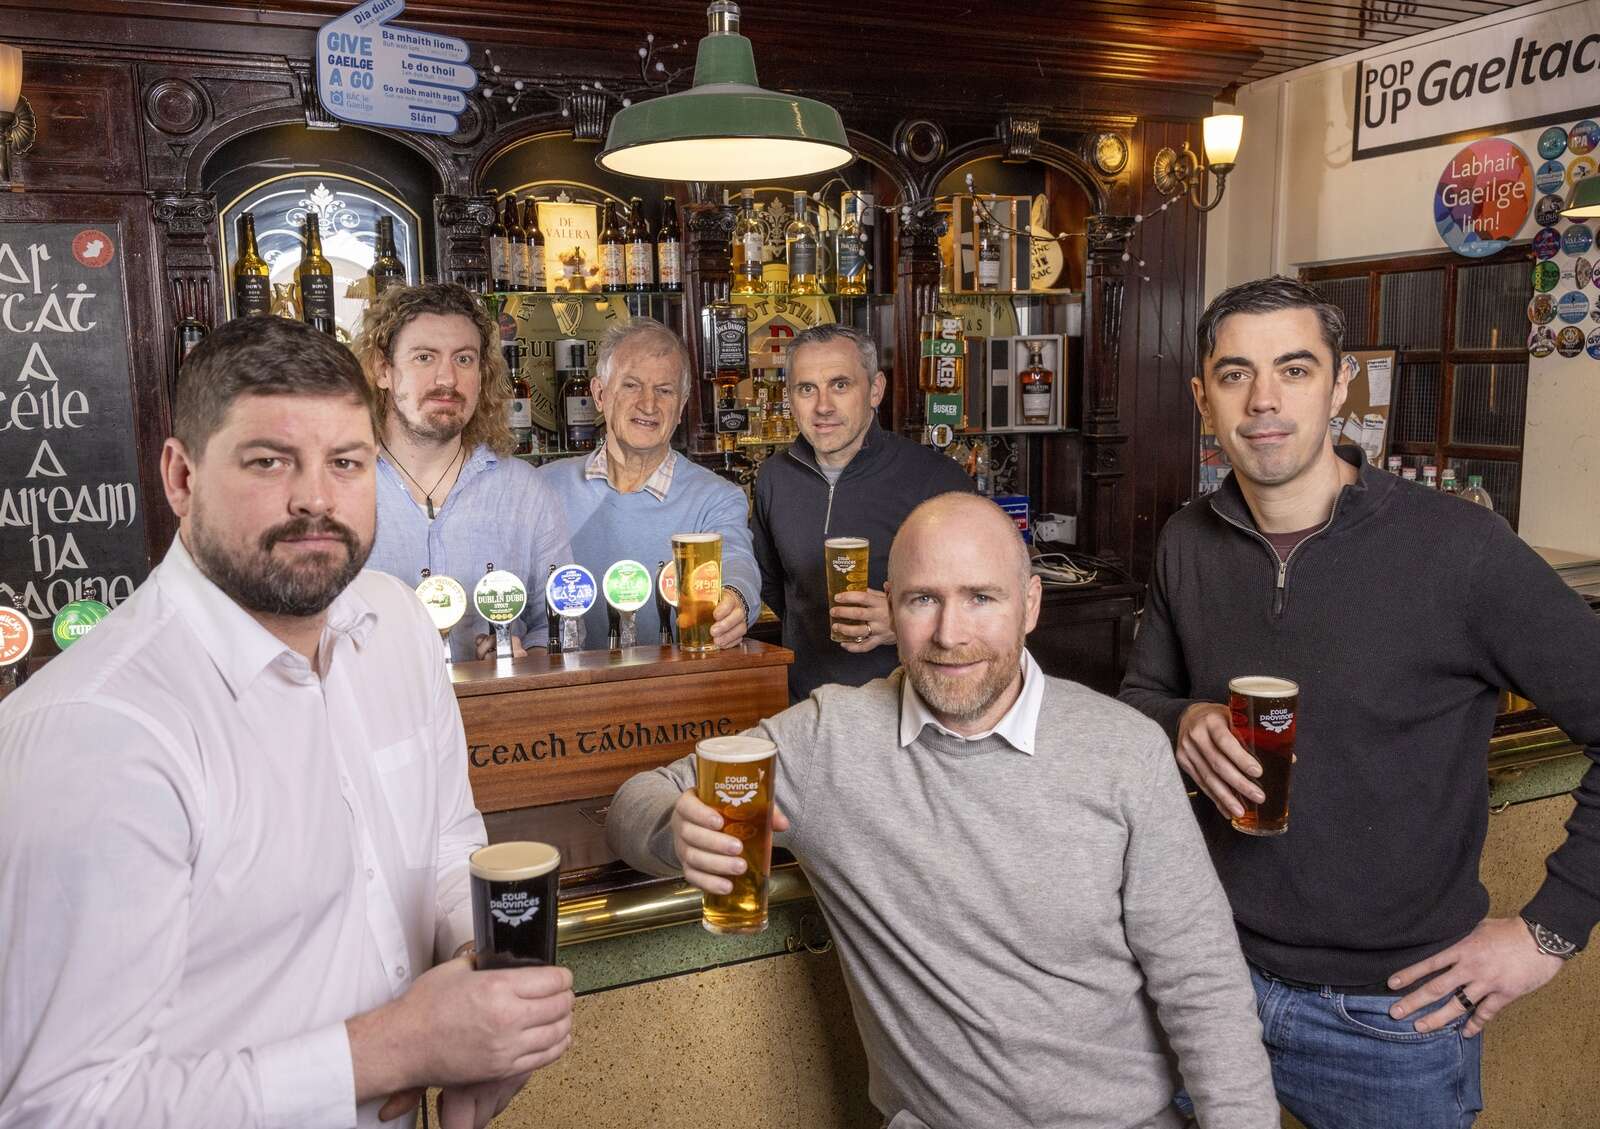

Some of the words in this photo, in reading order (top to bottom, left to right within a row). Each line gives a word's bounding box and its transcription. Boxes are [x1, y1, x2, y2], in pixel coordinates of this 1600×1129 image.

[353, 9, 374, 25] Dia
[327, 32, 373, 57] GIVE
[382, 31, 394, 39] Ba
[397, 34, 431, 47] mhaith
[328, 55, 374, 70] GAEILGE
[402, 60, 414, 70] Le
[416, 62, 429, 72] do
[432, 64, 455, 77] thoil
[1417, 33, 1600, 107] Gaeltac
[329, 69, 343, 87] A
[351, 71, 374, 90] GO
[1365, 60, 1414, 93] POP
[383, 84, 394, 92] Go
[395, 86, 417, 97] raibh
[418, 89, 441, 101] maith
[1364, 88, 1412, 129] UP
[410, 112, 437, 124] Slán!
[1452, 153, 1520, 179] Labhair
[1442, 178, 1526, 208] Gaeilge
[559, 217, 575, 227] DE
[1462, 212, 1500, 233] linn!
[546, 228, 591, 240] VALERA
[940, 319, 956, 388] BUSKER
[933, 403, 957, 414] BUSKER
[478, 594, 503, 604] DUBLIN
[714, 782, 758, 790] PROVINCES
[490, 897, 540, 909] PROVINCES
[502, 892, 527, 901] FOUR
